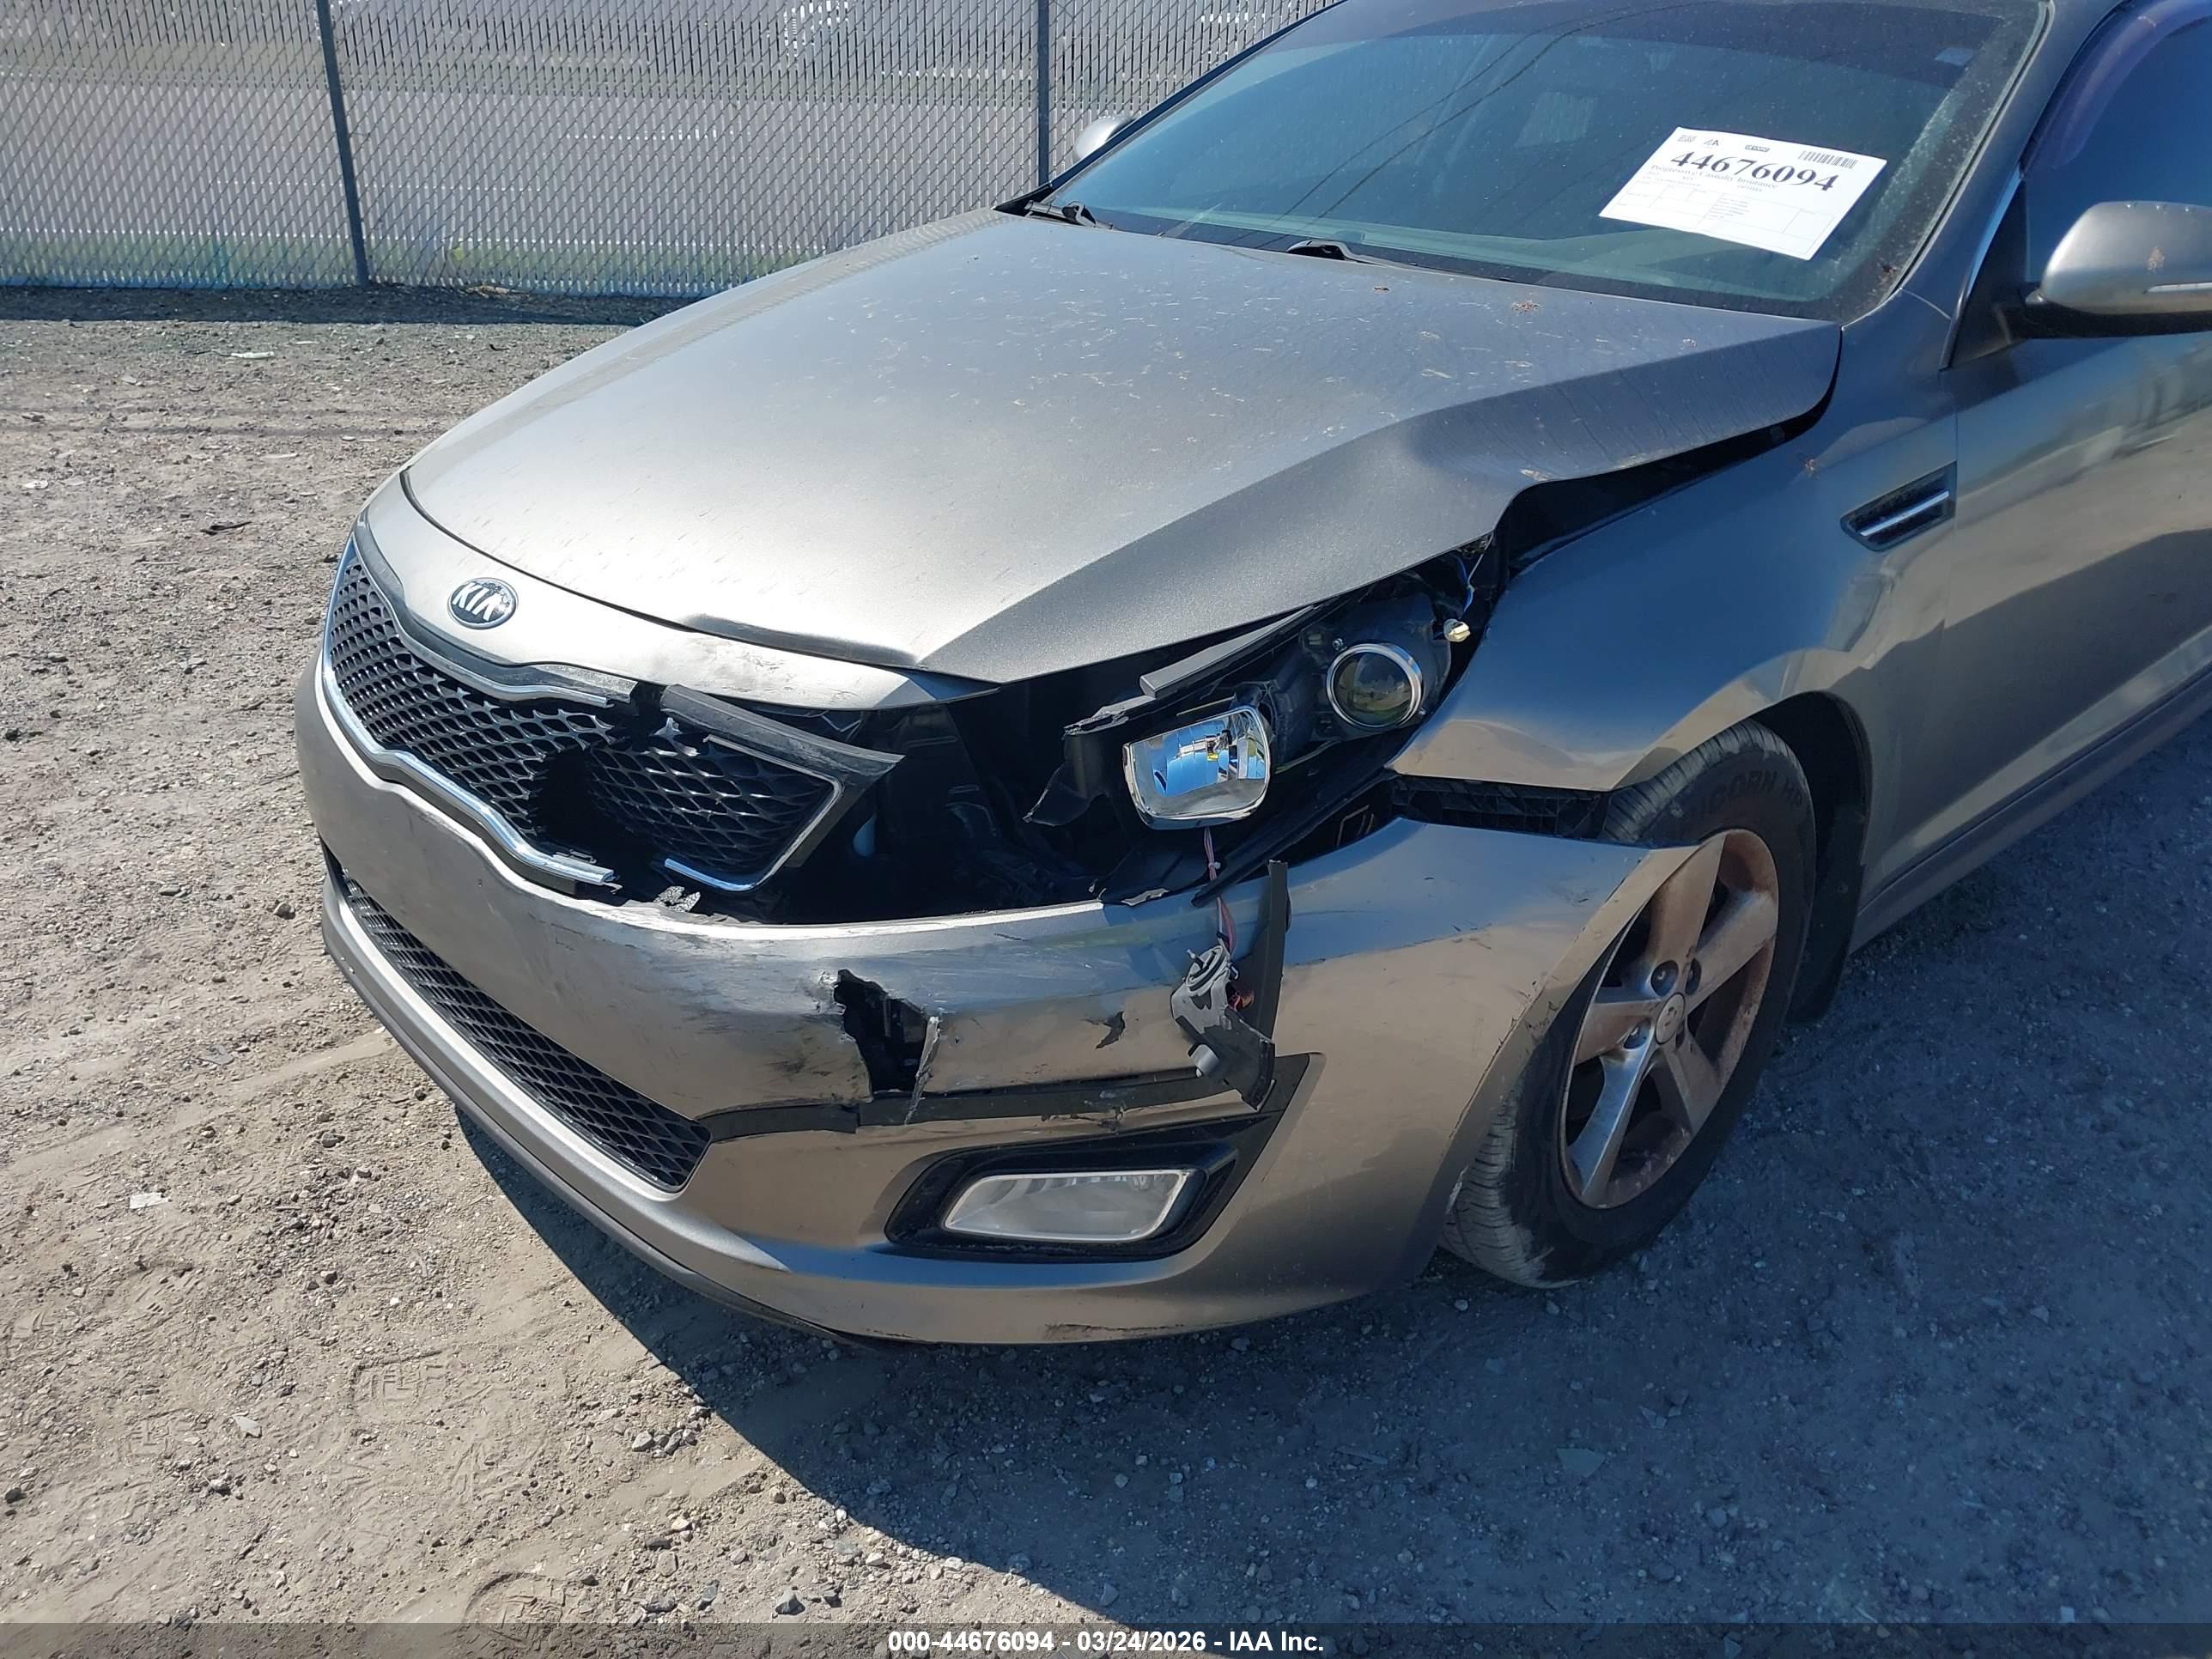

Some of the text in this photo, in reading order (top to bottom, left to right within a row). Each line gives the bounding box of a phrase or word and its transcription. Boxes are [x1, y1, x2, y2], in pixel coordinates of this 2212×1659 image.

[1650, 164, 1698, 176] Progressive
[1698, 170, 1734, 182] Casualty
[1737, 177, 1778, 188] Insurance
[1670, 151, 1838, 191] 44676094
[452, 581, 501, 622] KIA
